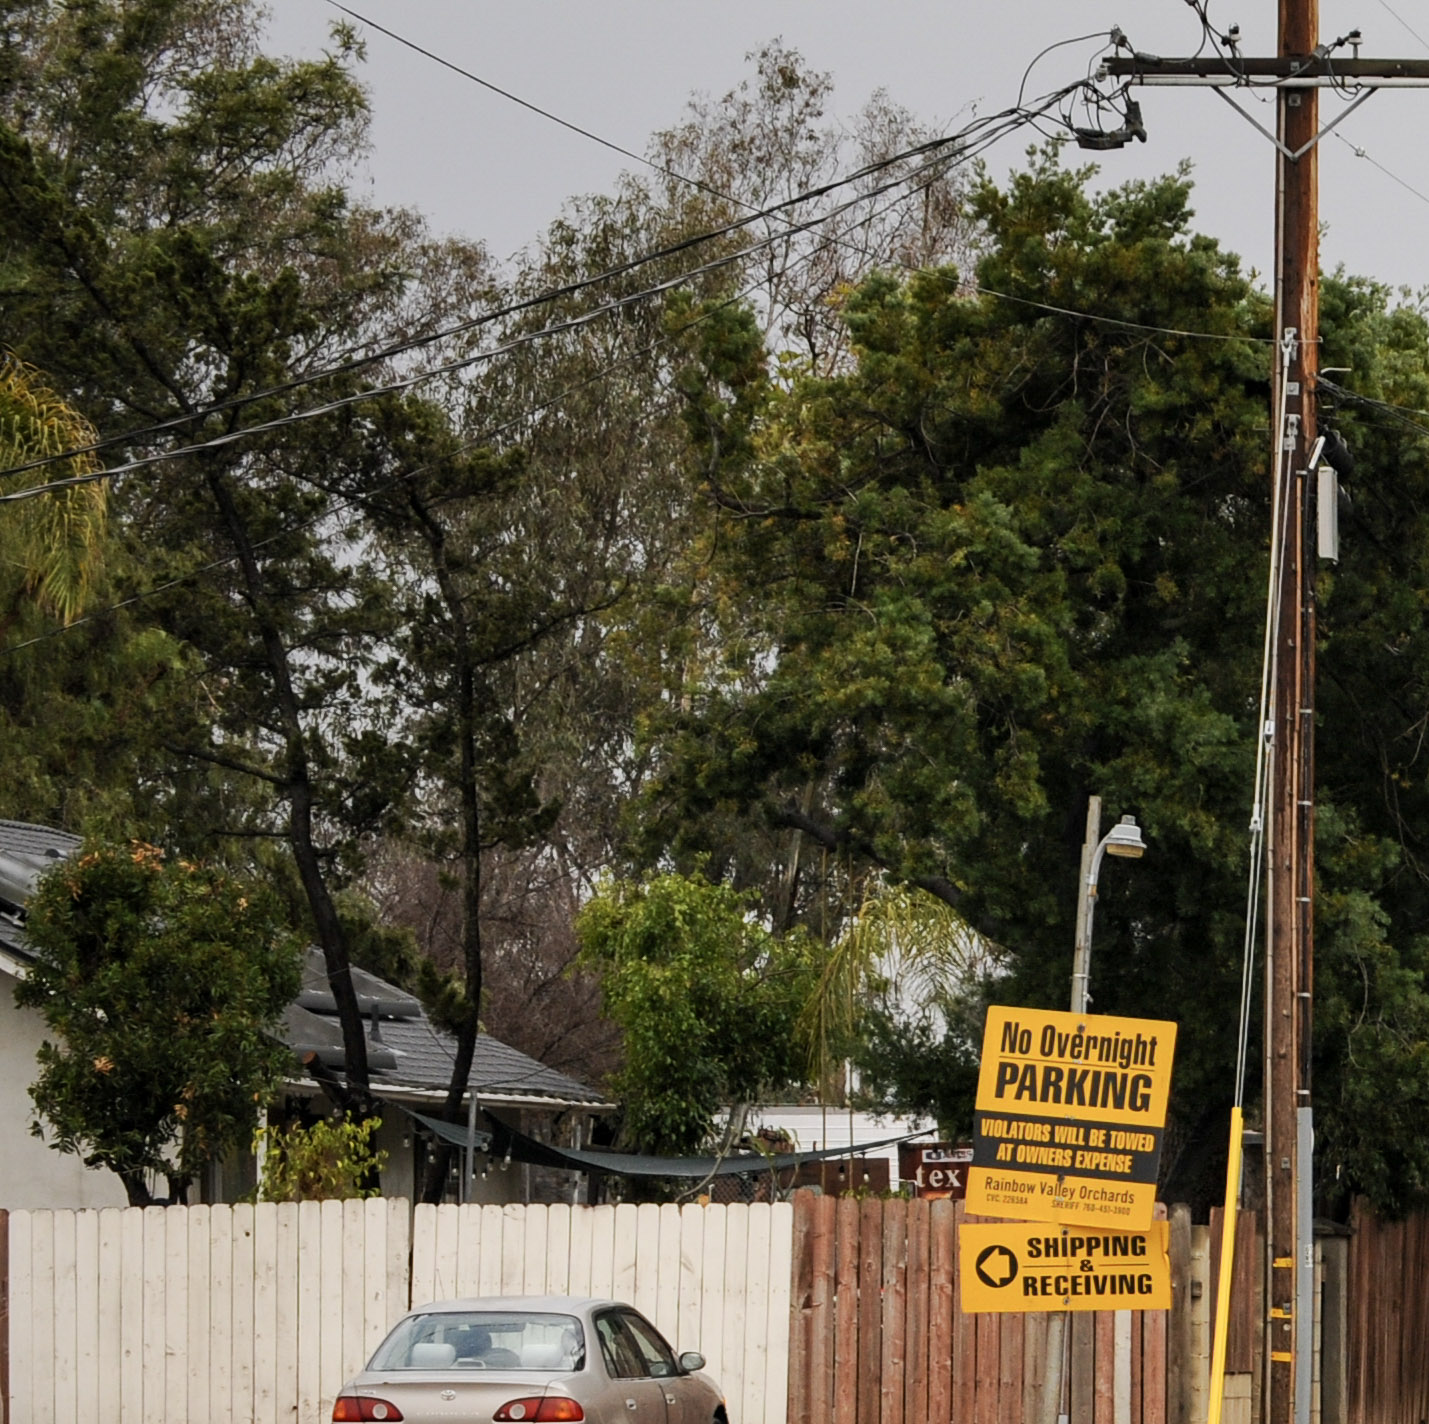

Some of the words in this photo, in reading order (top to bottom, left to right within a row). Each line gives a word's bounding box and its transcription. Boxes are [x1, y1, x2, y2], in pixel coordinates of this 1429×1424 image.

[1000, 1021, 1032, 1055] No
[1040, 1024, 1157, 1069] Overnight
[994, 1061, 1153, 1112] PARKING
[981, 1118, 1051, 1142] VIOLATORS
[1054, 1125, 1085, 1146] WILL
[1089, 1128, 1106, 1147] BE
[1109, 1131, 1155, 1152] TOWED
[996, 1143, 1014, 1161] AT
[1016, 1145, 1072, 1167] OWNERS
[1075, 1151, 1133, 1173] EXPENSE
[984, 1176, 1036, 1194] Rainbow
[1040, 1181, 1075, 1199] Valley
[1079, 1185, 1135, 1204] Orchards
[1051, 1199, 1079, 1211] SHERIFF
[1027, 1235, 1146, 1258] SHIPPING
[1079, 1259, 1094, 1272] &
[1023, 1274, 1152, 1296] RECEIVING
